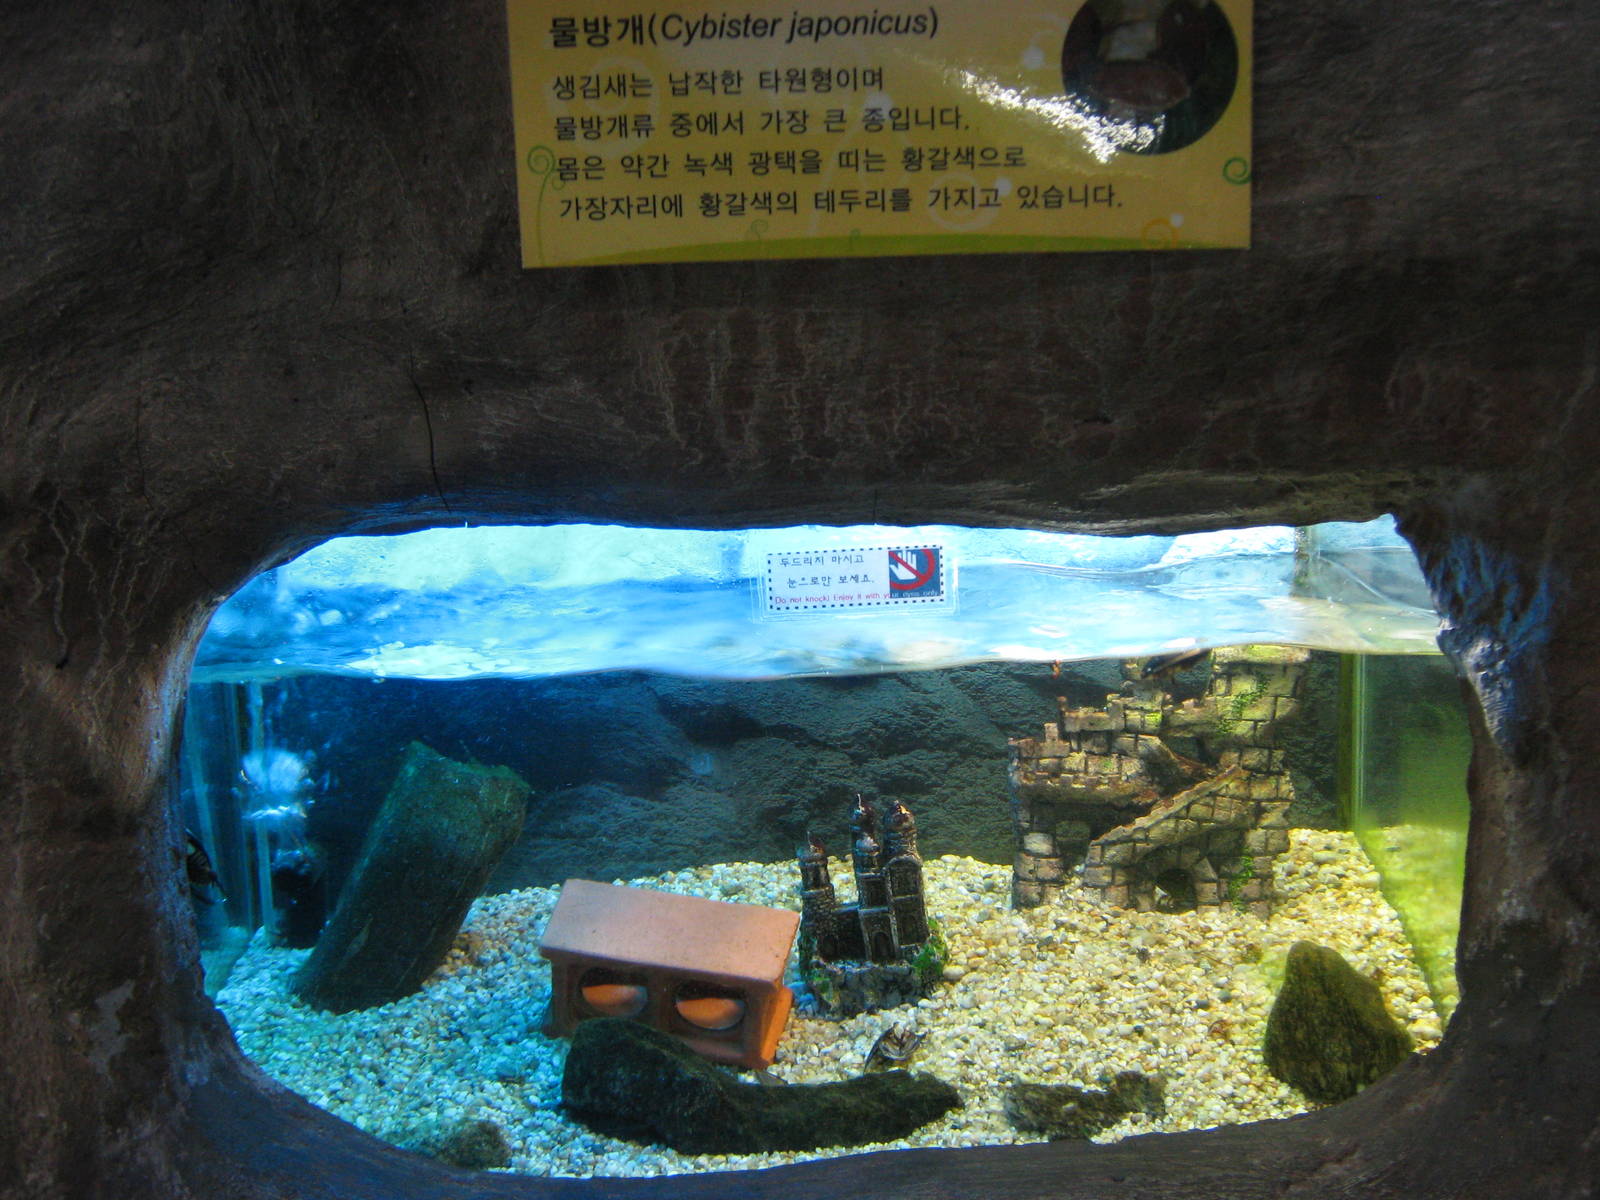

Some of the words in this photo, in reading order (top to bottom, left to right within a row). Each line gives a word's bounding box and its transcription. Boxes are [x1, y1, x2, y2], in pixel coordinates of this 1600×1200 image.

[549, 12, 782, 48] 물방개(Cybister
[786, 7, 939, 44] japonicus)
[552, 72, 653, 101] 생김새는
[668, 69, 743, 97] 납작한
[759, 66, 884, 94] 타원형이며
[554, 113, 656, 141] 물방개류
[670, 111, 744, 138] 중에서
[760, 109, 810, 135] 가장
[823, 108, 847, 133] 큰
[861, 105, 970, 132] 종입니다.
[556, 156, 605, 182] 몸은
[620, 154, 670, 179] 약간
[684, 152, 734, 176] 녹색
[748, 150, 823, 176] 광택을
[838, 148, 887, 173] 띠는
[901, 146, 1027, 173] 황갈색으로
[559, 194, 684, 221] 가장자리에
[699, 191, 798, 217] 황갈색의
[814, 188, 911, 214] 테두리를
[928, 187, 1001, 212] 가지고
[1016, 183, 1123, 210] 있습니다.
[780, 556, 825, 567] 두드리지
[831, 554, 864, 565] 마시고
[787, 576, 832, 588] 눈으로만
[839, 574, 875, 584] 보세요.
